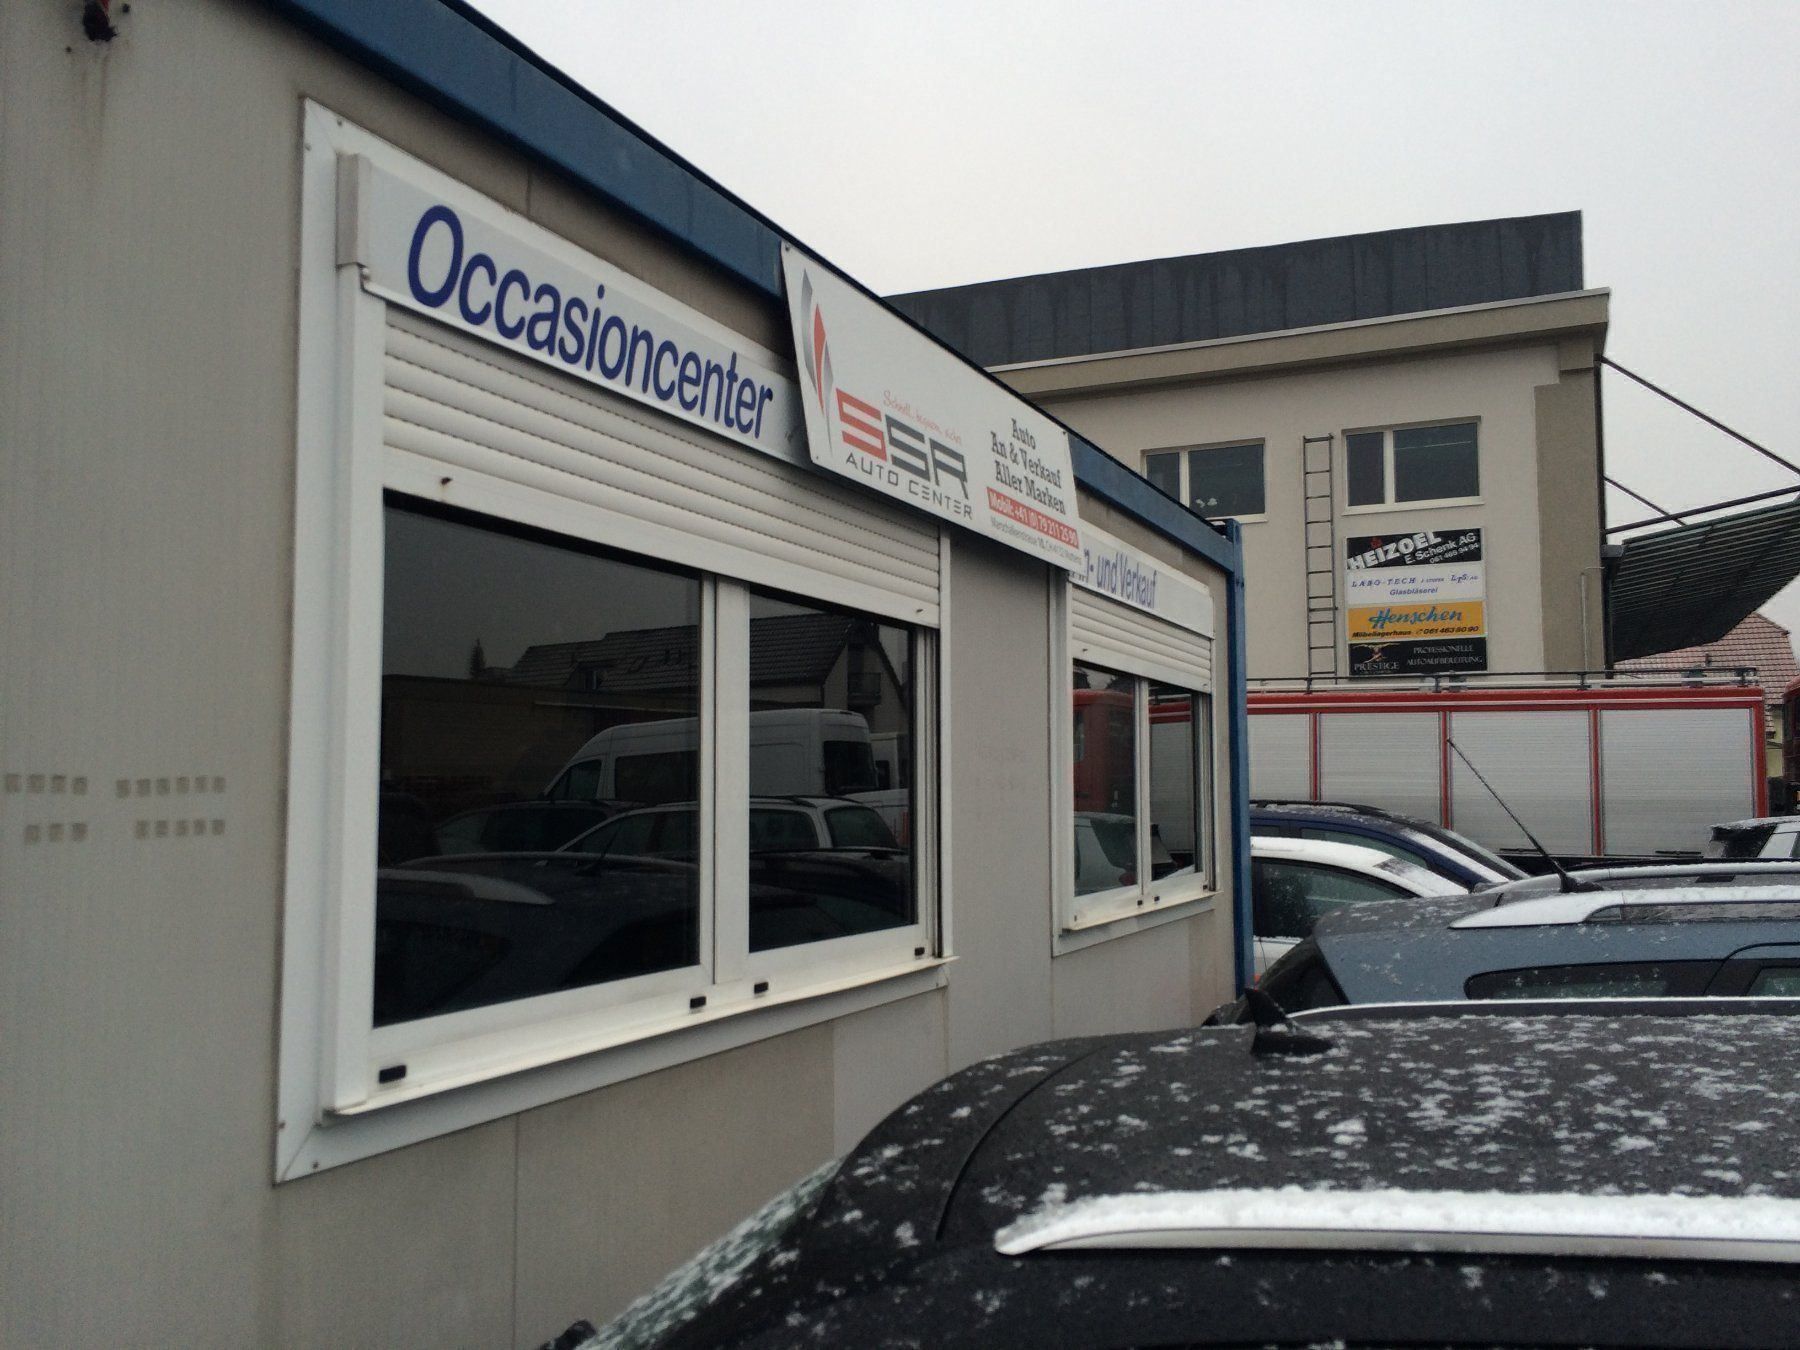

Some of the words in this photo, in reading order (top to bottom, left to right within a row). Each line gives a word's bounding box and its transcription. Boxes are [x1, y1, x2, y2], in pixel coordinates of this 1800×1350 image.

[407, 204, 773, 439] Occasioncenter
[836, 387, 969, 500] SSR
[1011, 418, 1036, 450] Auto
[990, 430, 1007, 459] An
[1009, 442, 1020, 466] &
[1019, 448, 1062, 489] Verkauf
[846, 452, 899, 487] AUTO
[908, 480, 973, 520] CENTER
[995, 460, 1023, 494] Aller
[1023, 475, 1066, 515] Marken
[1347, 530, 1441, 569] HEIZOEL
[1404, 553, 1416, 564] E.
[1415, 540, 1457, 560] Schenk
[1459, 533, 1476, 546] AG
[1097, 551, 1118, 595] und
[1119, 551, 1157, 609] Verkauf
[1389, 587, 1438, 596] Glasbläserei
[1368, 606, 1462, 630] Henschen
[1423, 627, 1438, 635] 061
[1354, 661, 1399, 671] PRESTIGE
